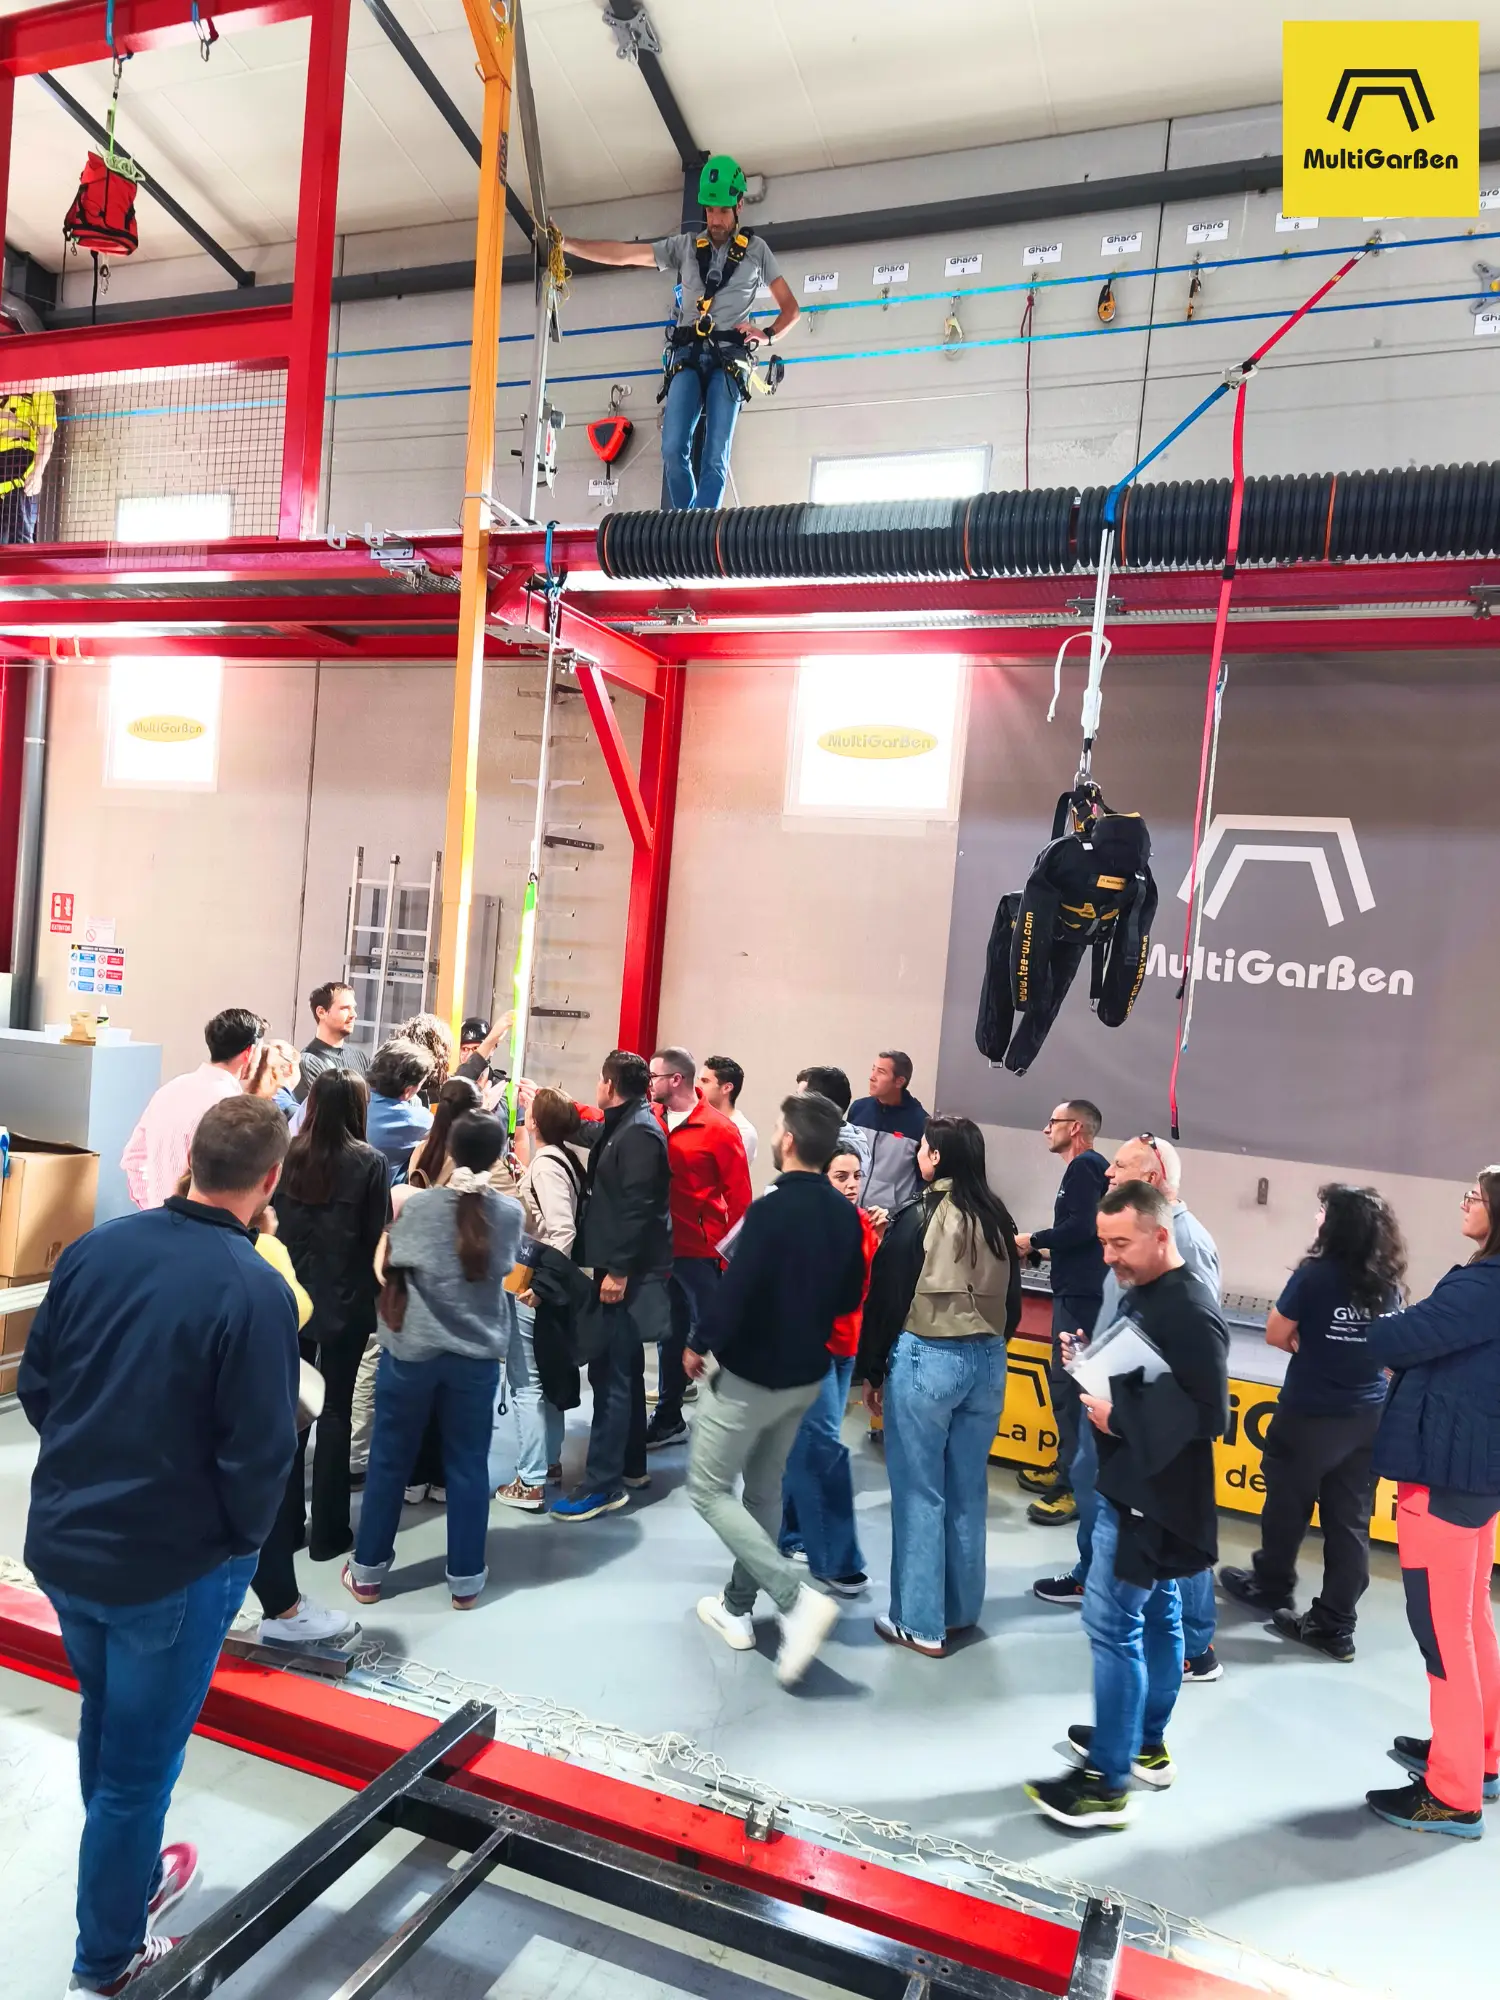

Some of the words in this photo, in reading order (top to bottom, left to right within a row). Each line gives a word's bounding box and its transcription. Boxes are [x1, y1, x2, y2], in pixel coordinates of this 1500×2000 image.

[1192, 221, 1224, 232] Gharo
[1293, 221, 1300, 230] 8
[1106, 233, 1137, 244] Gharo
[1204, 233, 1210, 241] 7
[1028, 244, 1058, 255] Gharo
[949, 255, 978, 265] Gharo
[1039, 256, 1044, 264] 5
[877, 263, 905, 274] Gharo
[808, 272, 835, 282] Gharo
[888, 275, 893, 283] 3
[818, 283, 823, 291] 2
